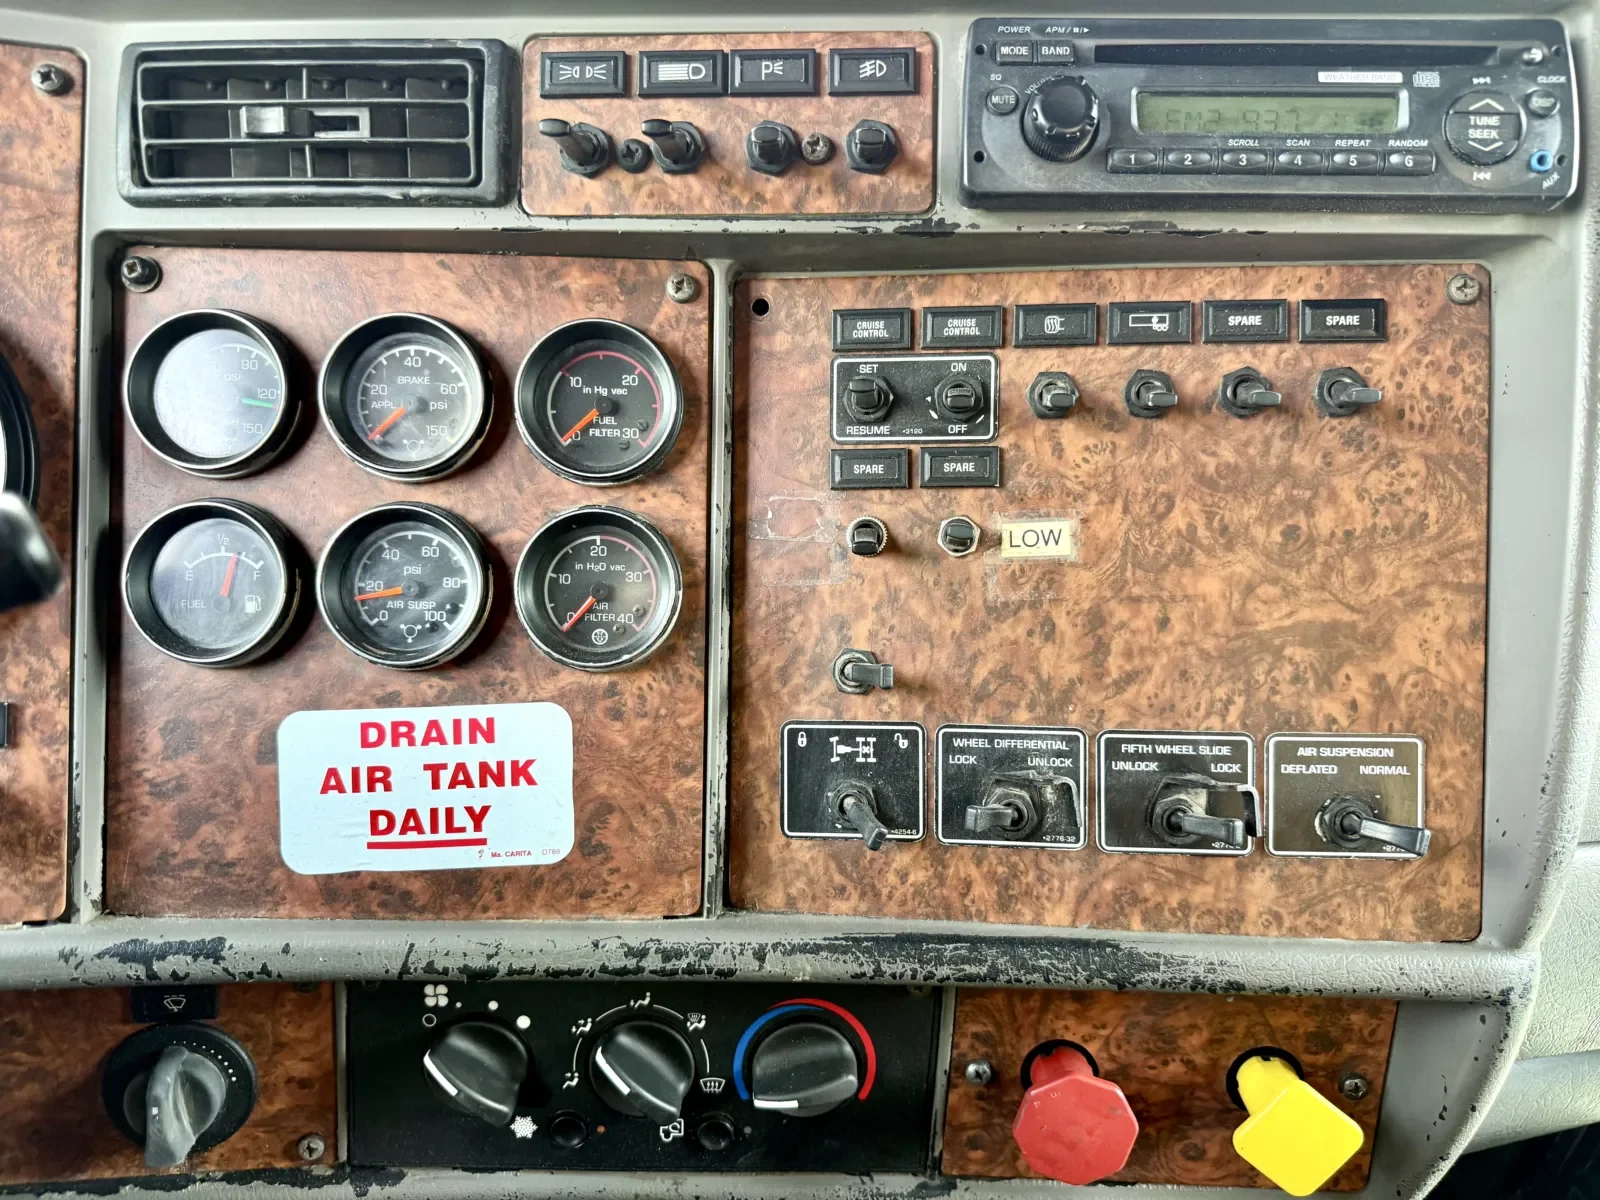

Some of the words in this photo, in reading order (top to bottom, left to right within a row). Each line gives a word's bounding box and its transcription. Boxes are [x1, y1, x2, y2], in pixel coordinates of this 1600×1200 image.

[1001, 46, 1028, 55] MODE
[1041, 46, 1070, 55] BAND
[1324, 73, 1368, 81] WEATHER
[1537, 76, 1566, 84] CLOCK
[991, 95, 1015, 104] MUTE
[1469, 116, 1500, 126] TUNE
[1468, 129, 1498, 139] SEEK
[1228, 139, 1260, 147] SCROLL
[1286, 139, 1310, 147] SCAN
[1335, 139, 1371, 147] REPEAT
[1388, 139, 1428, 147] RANDOM
[1129, 155, 1135, 165] 1
[1184, 155, 1193, 165] 2
[1239, 155, 1247, 165] 3
[1294, 155, 1302, 165] 4
[1349, 155, 1357, 166] 5
[1404, 156, 1413, 167] 6
[857, 321, 885, 329] CRUISE
[947, 319, 976, 328] CRUISE
[1228, 315, 1263, 326] SPARE
[1326, 315, 1360, 326] SPARE
[853, 329, 889, 338] CONTROL
[943, 327, 980, 336] CONTROL
[404, 357, 421, 368] 40
[951, 363, 967, 372] ON
[859, 364, 878, 374] SET
[397, 376, 430, 385] BRAKE
[570, 376, 582, 388] 10
[622, 375, 639, 386] 20
[257, 388, 277, 400] 120
[370, 384, 388, 395] 20
[440, 384, 458, 395] 60
[583, 386, 592, 394] in
[594, 386, 608, 396] Hg
[371, 401, 397, 409] APPL
[430, 401, 448, 412] psi
[592, 417, 617, 425] FUEL
[243, 423, 263, 434] 150
[426, 425, 448, 436] 150
[589, 428, 621, 437] FILTER
[622, 428, 639, 439] 30
[846, 425, 890, 435] RESUME
[948, 425, 968, 434] OFF
[853, 464, 884, 474] SPARE
[943, 462, 975, 472] SPARE
[1008, 528, 1062, 548] LOW
[382, 549, 400, 561] 40
[421, 546, 440, 558] 60
[590, 546, 607, 557] 20
[403, 563, 422, 576] psi
[575, 562, 583, 570] in
[185, 570, 193, 581] E
[253, 570, 261, 581] F
[558, 574, 571, 585] 10
[625, 571, 642, 582] 30
[366, 580, 384, 592] 20
[442, 577, 461, 588] 80
[181, 600, 206, 609] FUEL
[386, 600, 404, 609] AIR
[408, 601, 436, 610] SUSP
[592, 602, 608, 610] AIR
[379, 610, 389, 621] 0
[424, 610, 446, 622] 100
[584, 613, 616, 622] FILTER
[617, 613, 634, 624] 40
[360, 716, 496, 749] DRAIN
[952, 737, 992, 748] WHEEL
[994, 738, 1070, 750] DIFFERENTIAL
[1121, 744, 1153, 754] FIFTH
[1155, 744, 1197, 755] WHEEL
[1199, 745, 1232, 756] SLIDE
[1297, 747, 1318, 757] AIR
[1319, 747, 1394, 758] SUSPENSION
[949, 755, 977, 765] LOCK
[1027, 757, 1073, 767] UNLOCK
[1111, 760, 1158, 771] UNLOCK
[1211, 763, 1241, 773] LOCK
[1281, 764, 1338, 775] DEFLATED
[1359, 765, 1410, 776] NORMAL
[320, 765, 393, 795] AIR
[423, 758, 539, 791] TANK
[369, 805, 492, 836] DAILY
